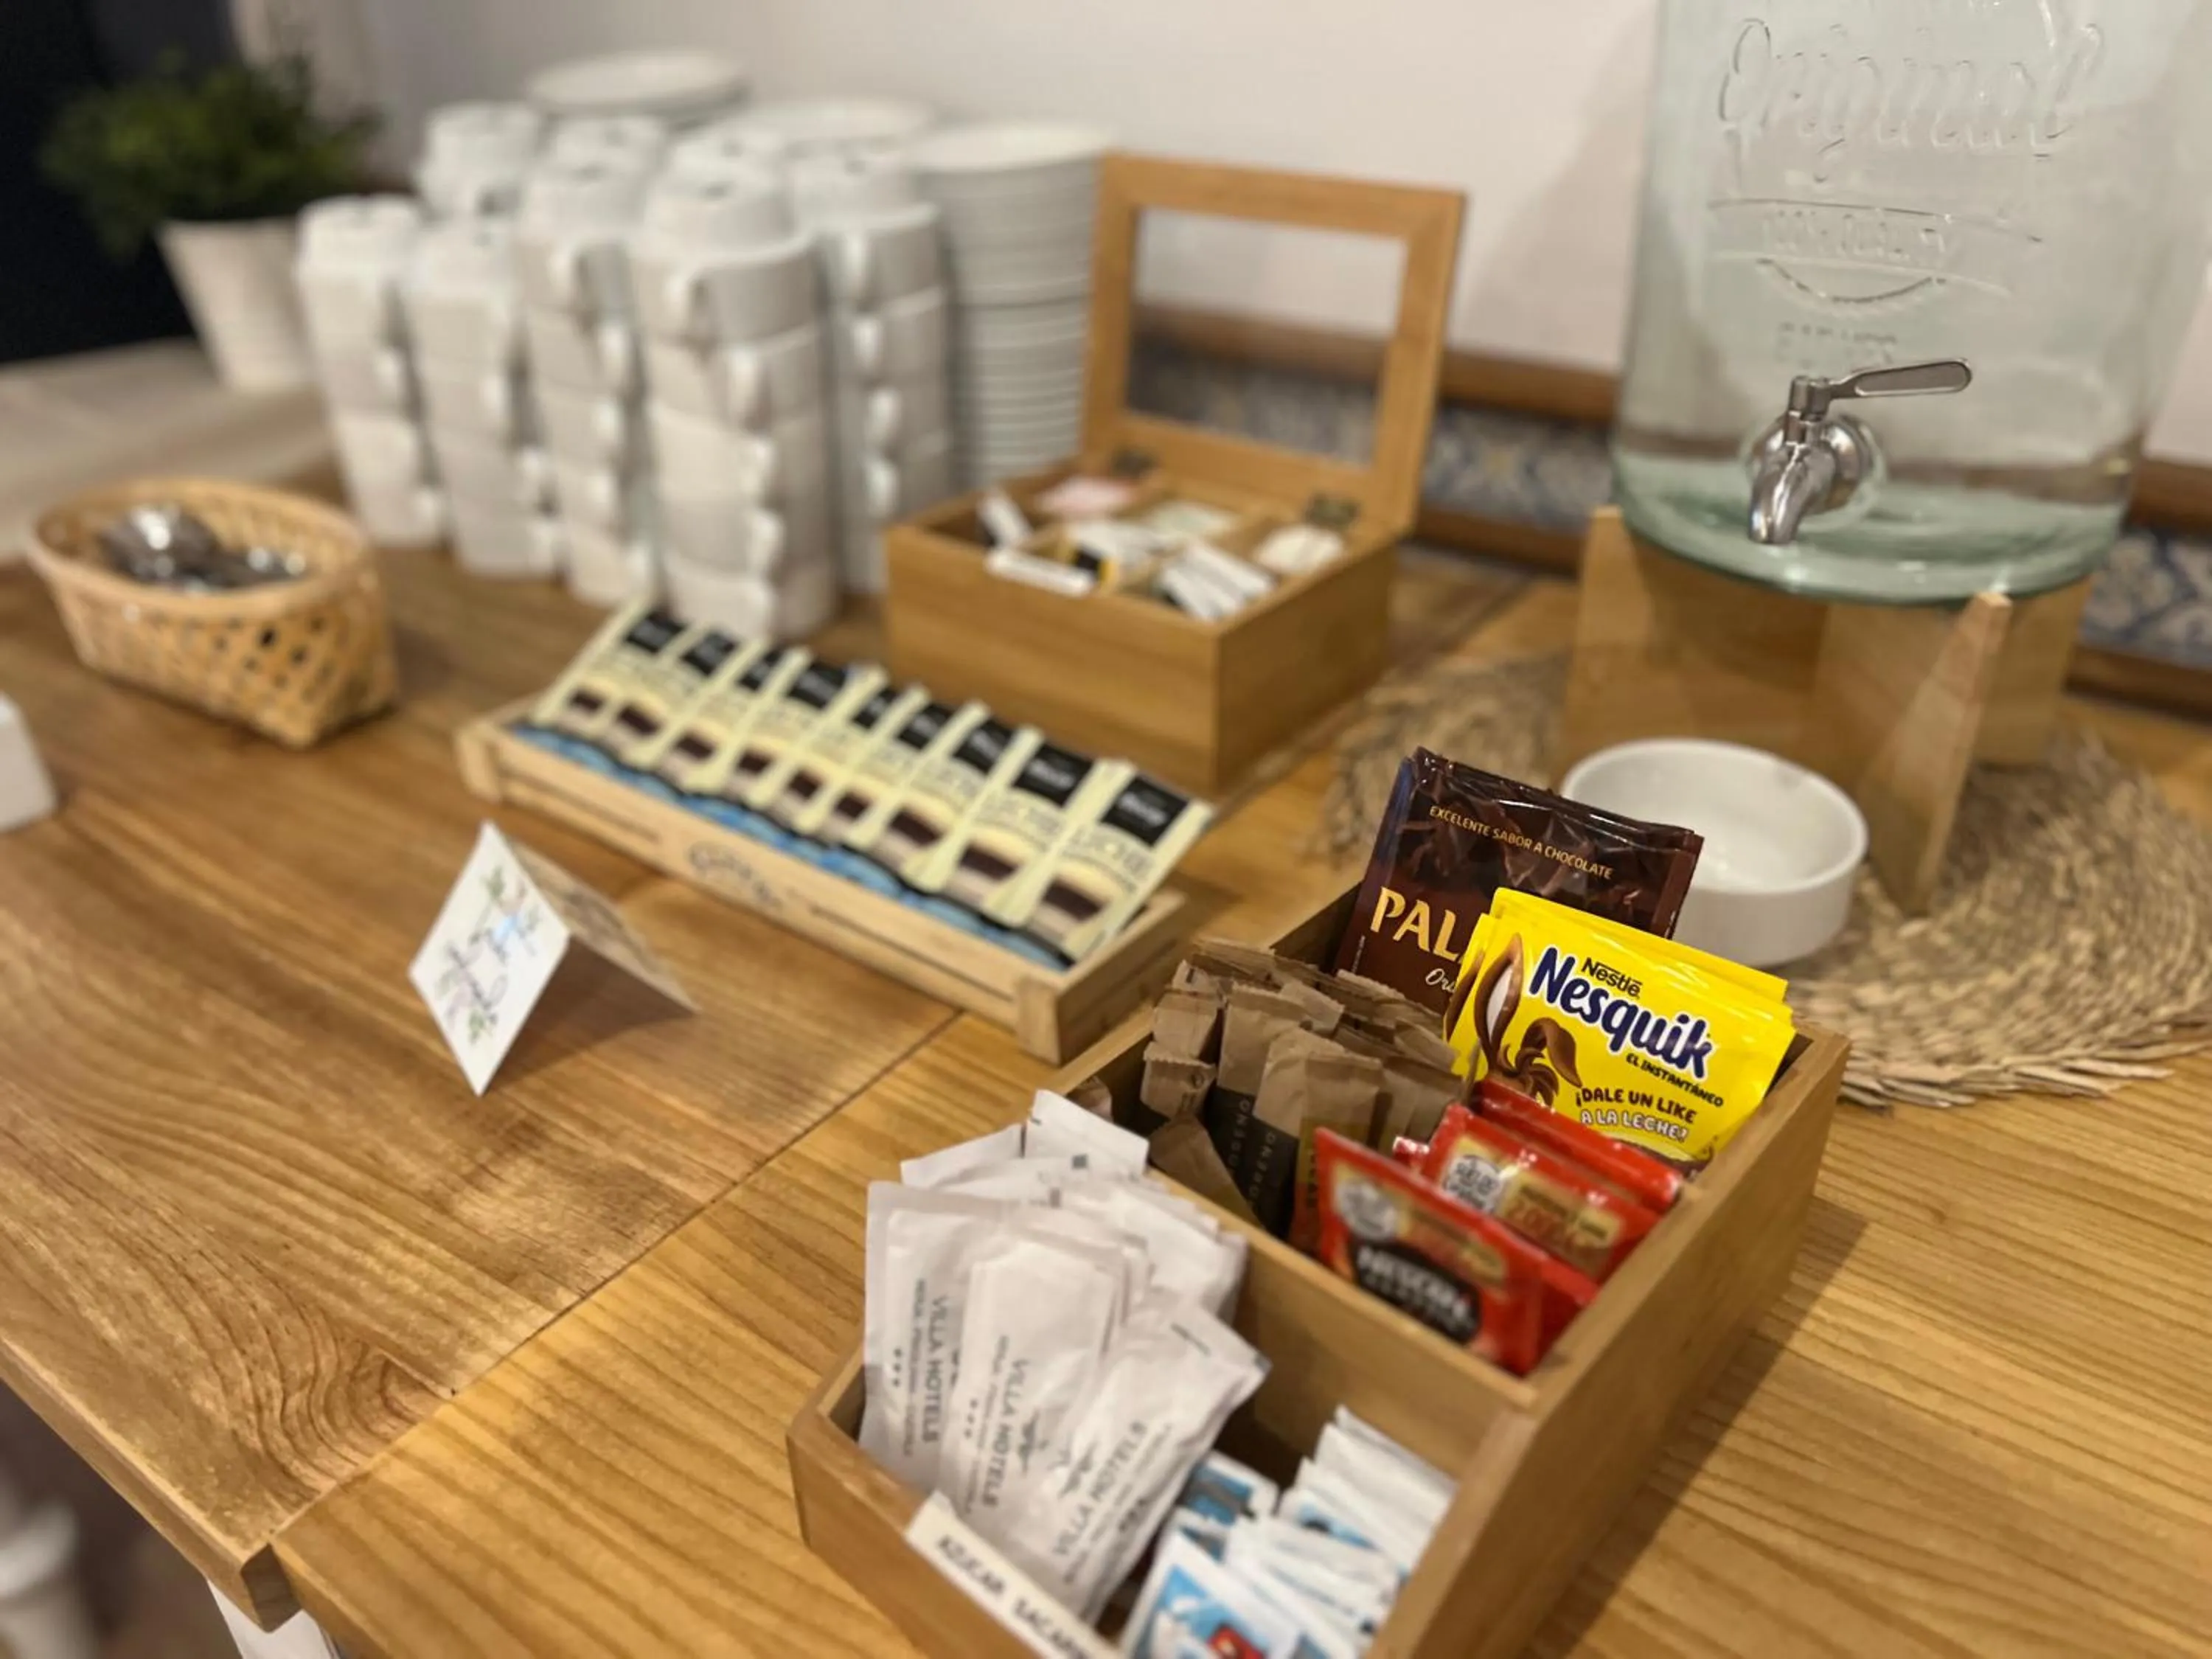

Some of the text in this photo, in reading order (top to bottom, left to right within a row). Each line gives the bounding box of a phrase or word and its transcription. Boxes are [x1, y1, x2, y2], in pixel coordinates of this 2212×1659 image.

[1429, 805, 1613, 880] EXCELENTE SABOR A CHOCOLATE
[1370, 886, 1462, 964] PAL
[1425, 967, 1458, 994] Ori
[1527, 945, 1714, 1080] Nesquik
[1576, 1088, 1697, 1124] ¡DALE UN LIKE
[1626, 1053, 1724, 1107] EL INSTANTÁNEO
[1580, 1108, 1593, 1126] A
[1596, 1107, 1618, 1127] LA
[922, 1293, 947, 1443] VILLA HOTELS
[1002, 1358, 1031, 1417] VILLA
[982, 1423, 1013, 1509] HOTELS
